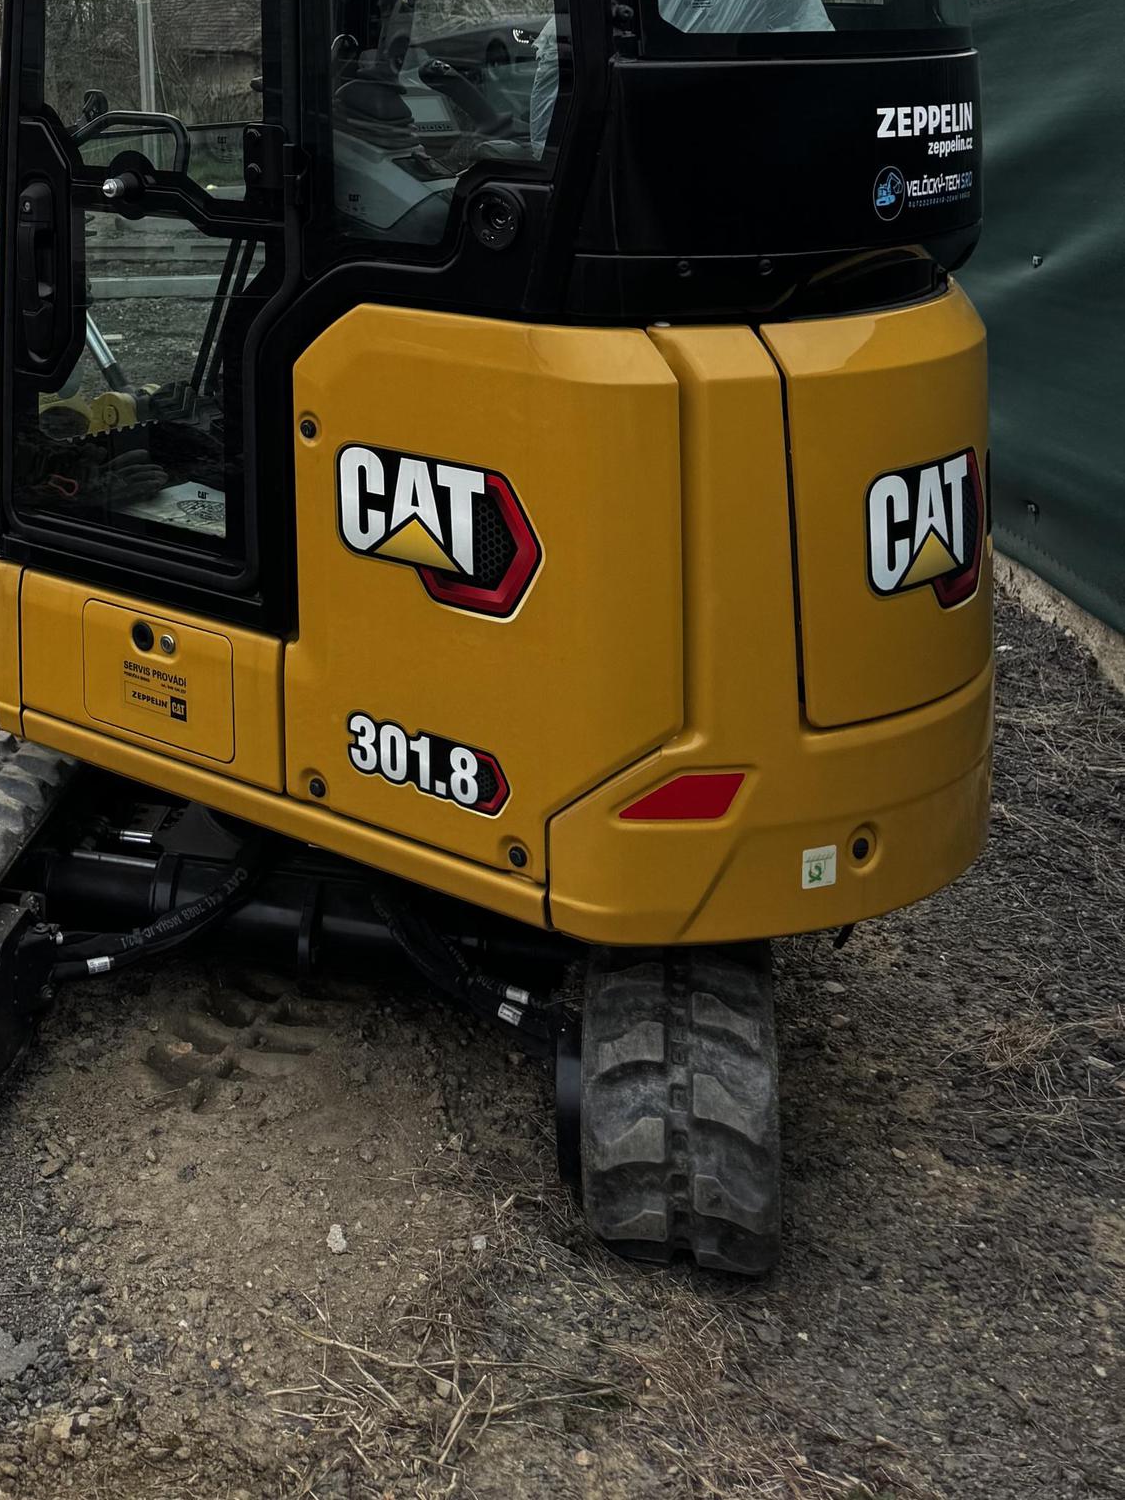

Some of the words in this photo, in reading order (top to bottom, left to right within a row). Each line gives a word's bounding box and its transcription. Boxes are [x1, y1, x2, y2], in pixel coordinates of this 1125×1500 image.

[877, 101, 973, 138] ZEPPELIN
[928, 134, 973, 158] zeppelin.cz
[340, 447, 484, 576] CAT
[869, 454, 967, 591] CAT
[123, 660, 151, 676] SERVIS
[152, 669, 187, 688] PROVÁDÍ
[131, 690, 167, 708] ZEPPELIN
[171, 701, 185, 715] CAT
[350, 715, 478, 805] 301.8
